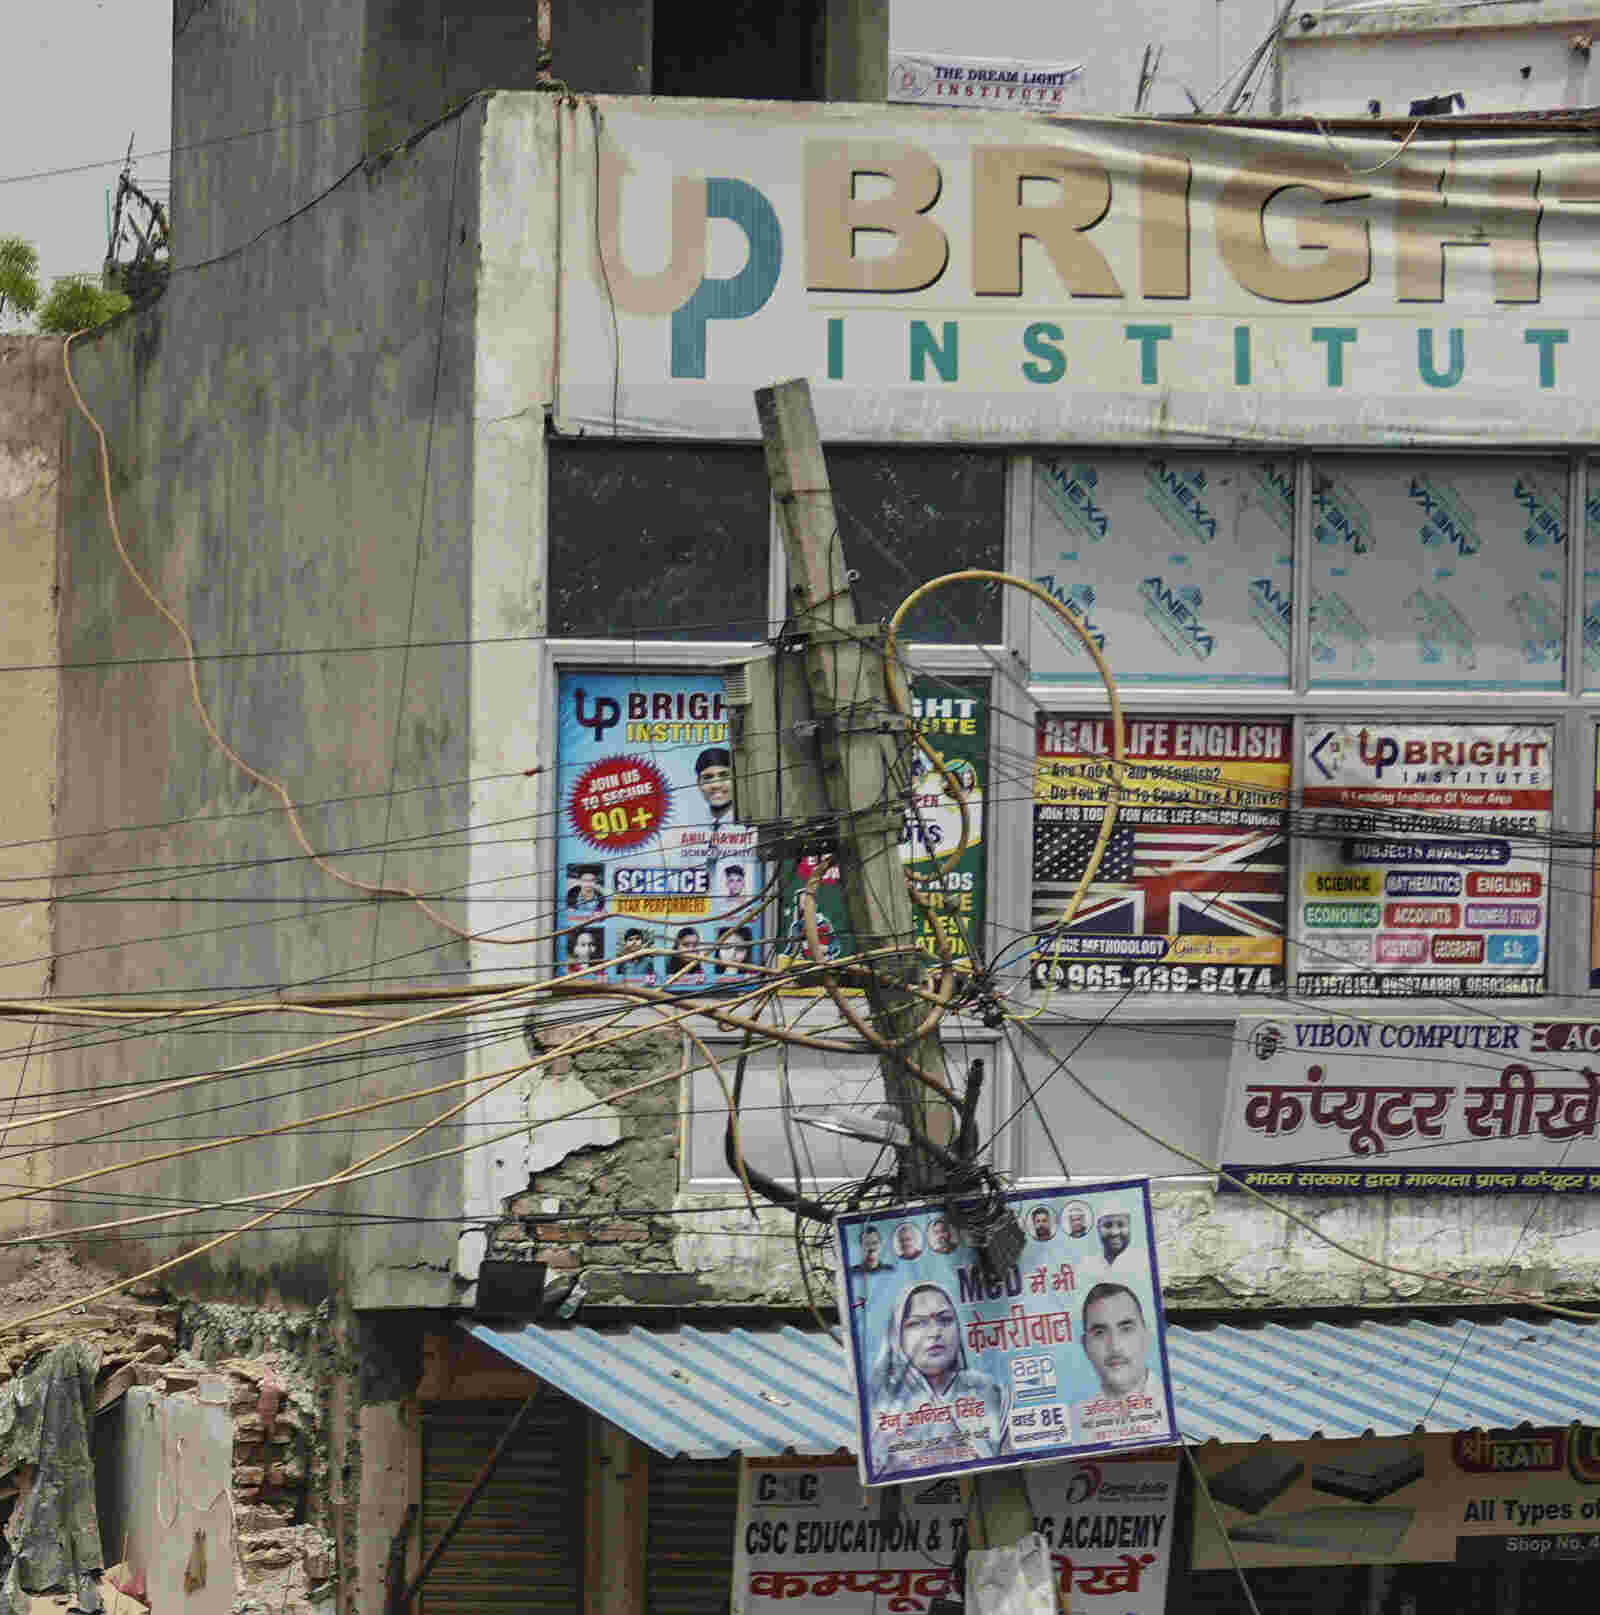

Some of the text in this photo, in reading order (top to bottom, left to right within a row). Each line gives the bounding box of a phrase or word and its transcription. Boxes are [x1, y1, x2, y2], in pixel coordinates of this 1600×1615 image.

[935, 66, 1068, 86] THE DREAM LIGHT
[936, 82, 1065, 104] INSTITUTE
[628, 692, 729, 721] BRIGH
[1044, 719, 1282, 759] REAL IFE ENGLISH
[1404, 740, 1547, 767] BRIGHT
[1403, 771, 1540, 785] INSTITUTE
[591, 806, 653, 840] 90+
[616, 869, 710, 894] SCIENCE
[1476, 877, 1532, 893] ENGLISH
[1295, 1023, 1371, 1049] VIBON
[1379, 1023, 1521, 1050] COMPUTER
[1245, 1171, 1294, 1187] भारत
[1298, 1172, 1361, 1188] सरकार
[1051, 1263, 1077, 1292] भी
[966, 1303, 1073, 1354] केजरीवाल
[1040, 1407, 1063, 1426] 8E
[1496, 1440, 1551, 1468] RAM
[758, 1473, 820, 1501] CC
[1464, 1498, 1497, 1521] All
[1503, 1498, 1570, 1526] Types
[745, 1520, 789, 1554] CSC
[793, 1518, 921, 1554] EDUCATION
[927, 1520, 942, 1550] &
[1057, 1514, 1167, 1549] ACADEMY
[1505, 1535, 1551, 1553] Shop
[1554, 1534, 1586, 1551] No.
[750, 1552, 1157, 1613] कम्प्यूट ीखें
